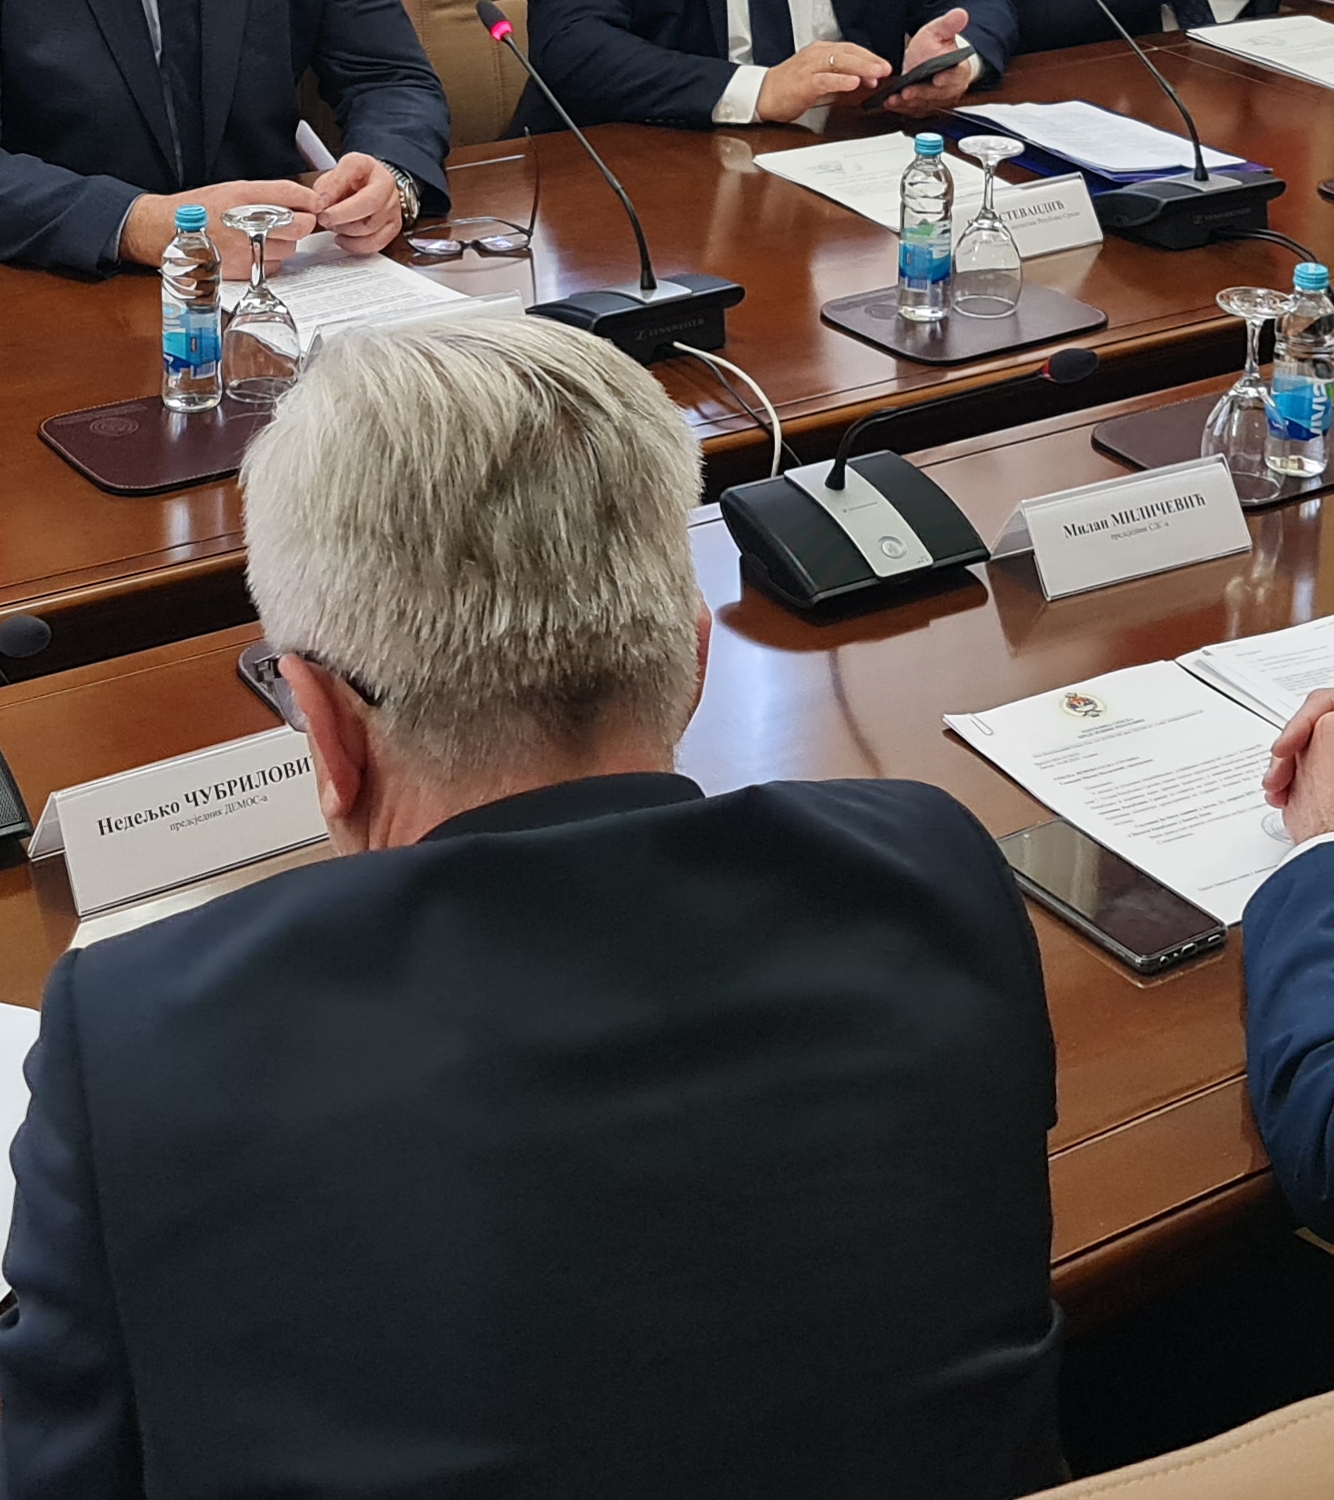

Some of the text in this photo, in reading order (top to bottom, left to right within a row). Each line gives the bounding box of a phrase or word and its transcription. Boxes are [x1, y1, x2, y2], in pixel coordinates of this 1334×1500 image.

[97, 755, 315, 836] Недељко ЧУБРИЛОВИ
[169, 795, 269, 832] предсједник ДЕМОС-а
